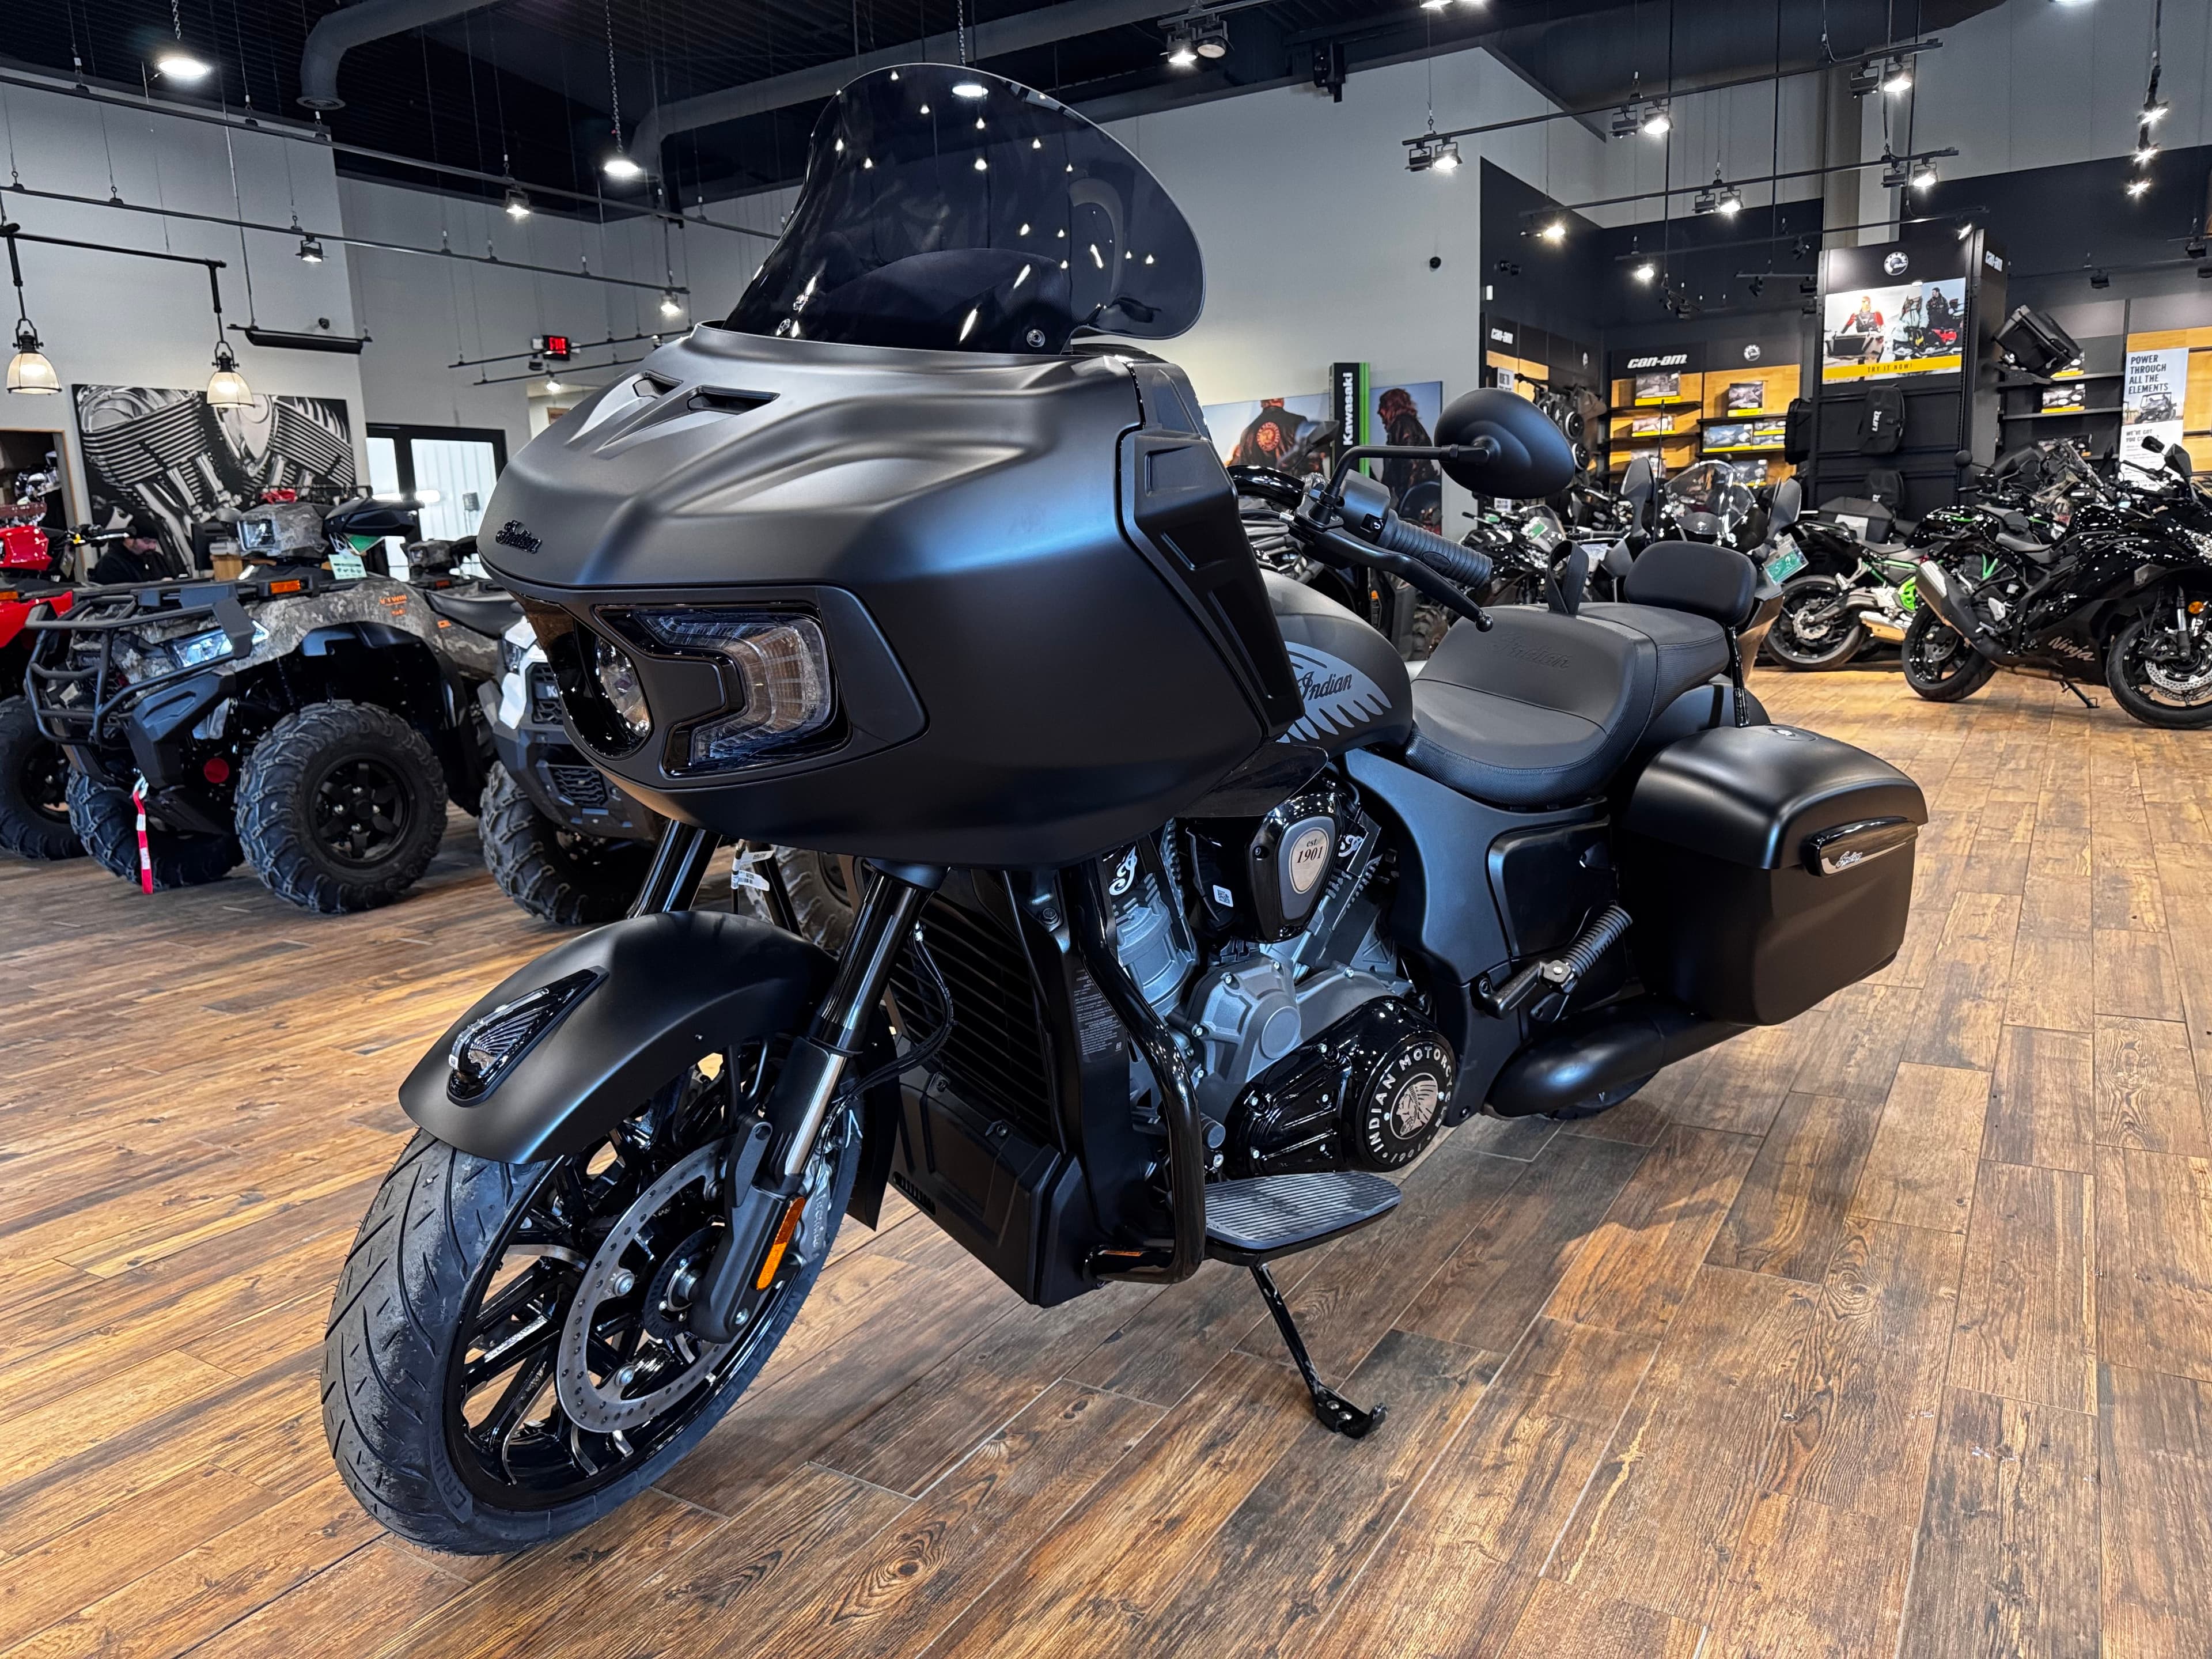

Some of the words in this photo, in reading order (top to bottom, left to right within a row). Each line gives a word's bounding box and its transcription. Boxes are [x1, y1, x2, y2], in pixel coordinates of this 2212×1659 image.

[1627, 354, 1687, 369] can-am
[2130, 354, 2159, 365] POWER
[2130, 363, 2166, 374] THROUGH
[2128, 382, 2168, 394] ELEMENTS
[2129, 375, 2142, 384] ALL
[2145, 374, 2159, 382] THE
[1343, 372, 1353, 445] Kawasaki
[495, 520, 542, 554] Indian
[1484, 632, 1574, 672] Indian
[2048, 636, 2096, 661] Ninja
[1298, 671, 1353, 701] Indian
[1297, 846, 1323, 863] 1901
[1368, 1073, 1397, 1153] INDIAN
